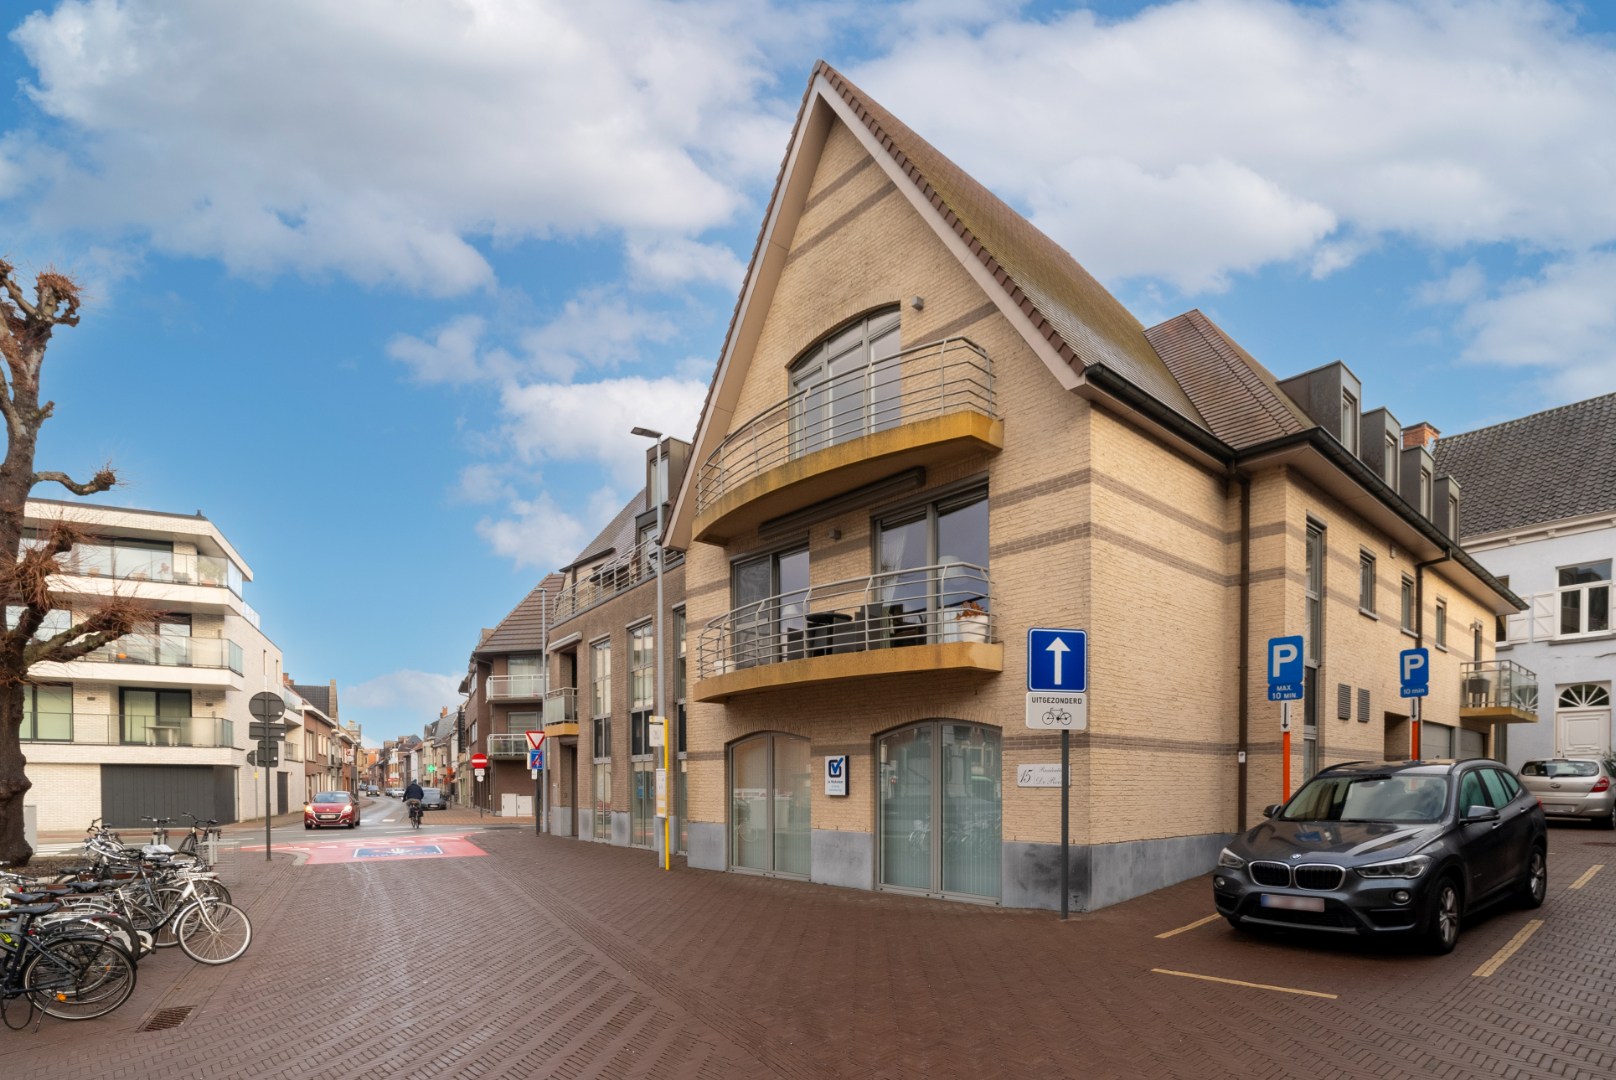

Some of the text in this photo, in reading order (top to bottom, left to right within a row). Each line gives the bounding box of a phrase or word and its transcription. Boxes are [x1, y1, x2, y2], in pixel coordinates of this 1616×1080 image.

[1273, 644, 1297, 677] P
[1404, 654, 1424, 680] P
[1020, 769, 1033, 783] 15
